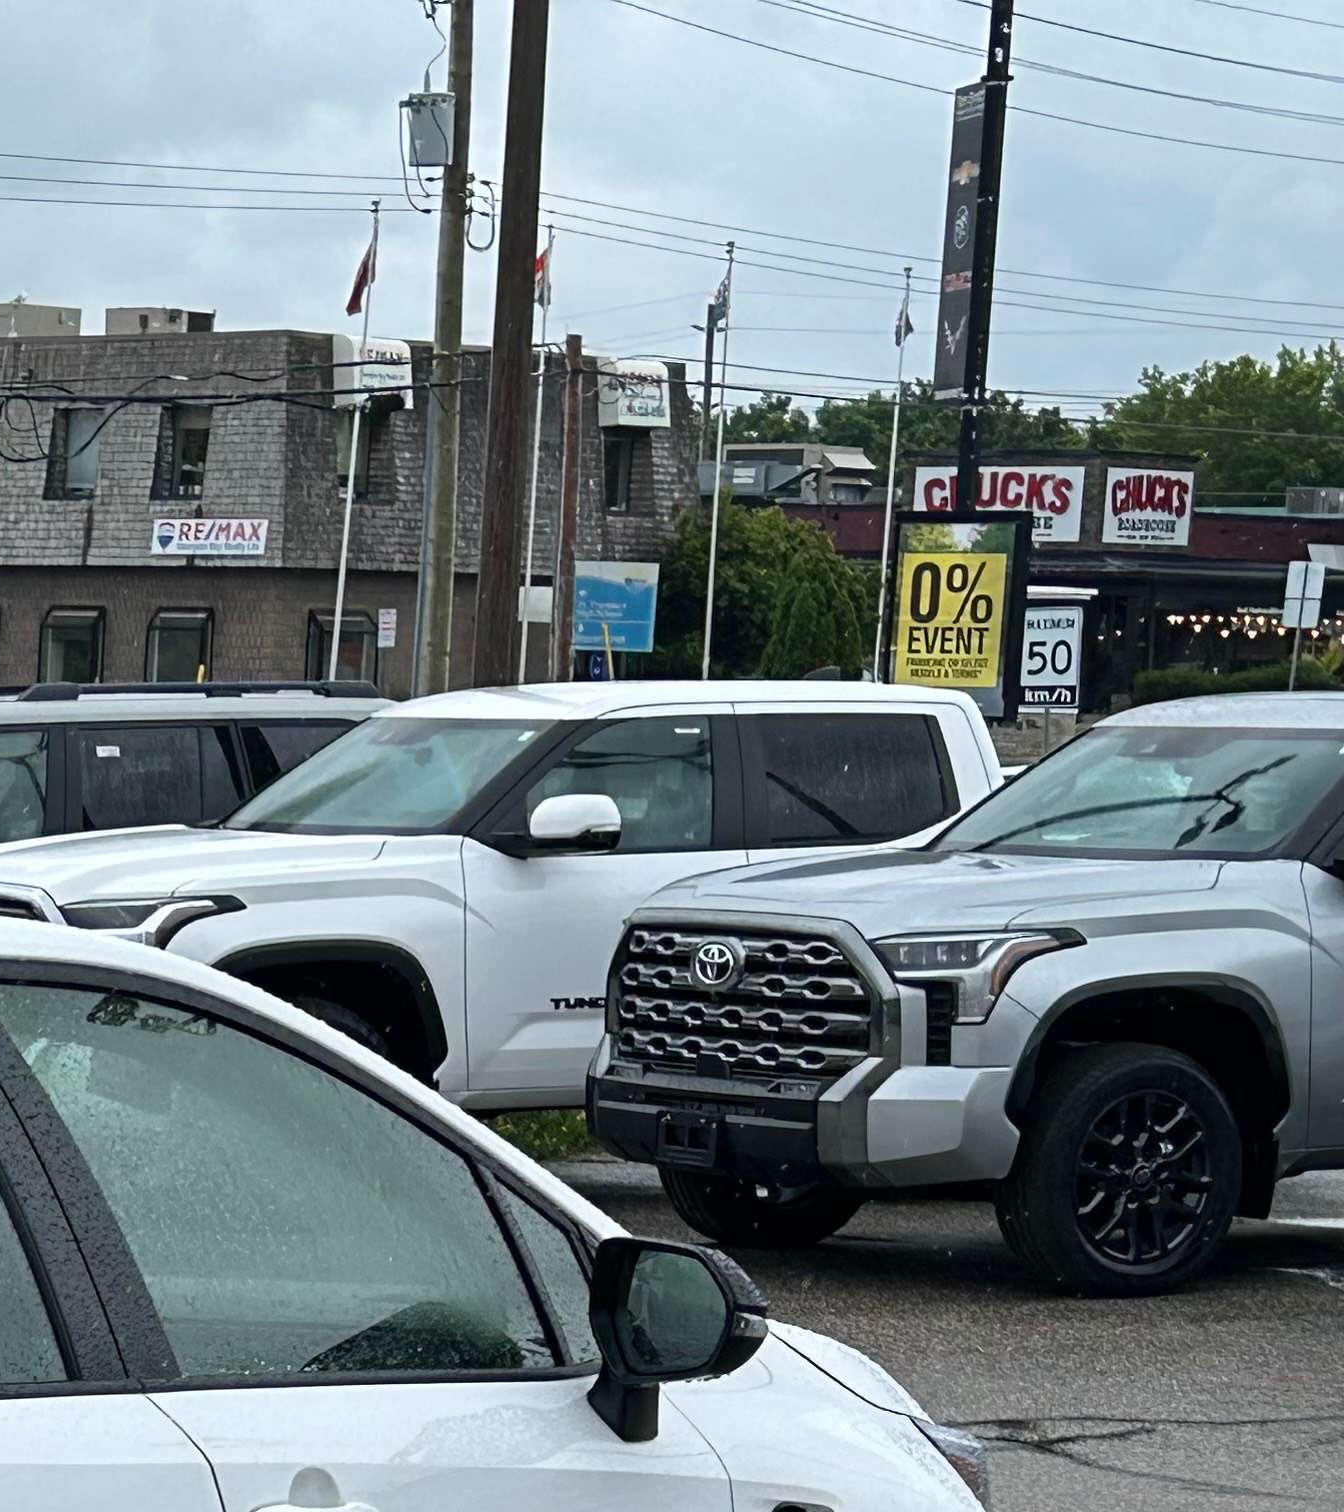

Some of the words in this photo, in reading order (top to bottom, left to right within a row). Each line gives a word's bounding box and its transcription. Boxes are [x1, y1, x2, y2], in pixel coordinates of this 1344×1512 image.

[178, 521, 262, 541] RE/MAX
[910, 562, 993, 624] 0%
[907, 627, 989, 655] EVENT
[1027, 640, 1072, 675] 50
[1025, 688, 1071, 703] km/h
